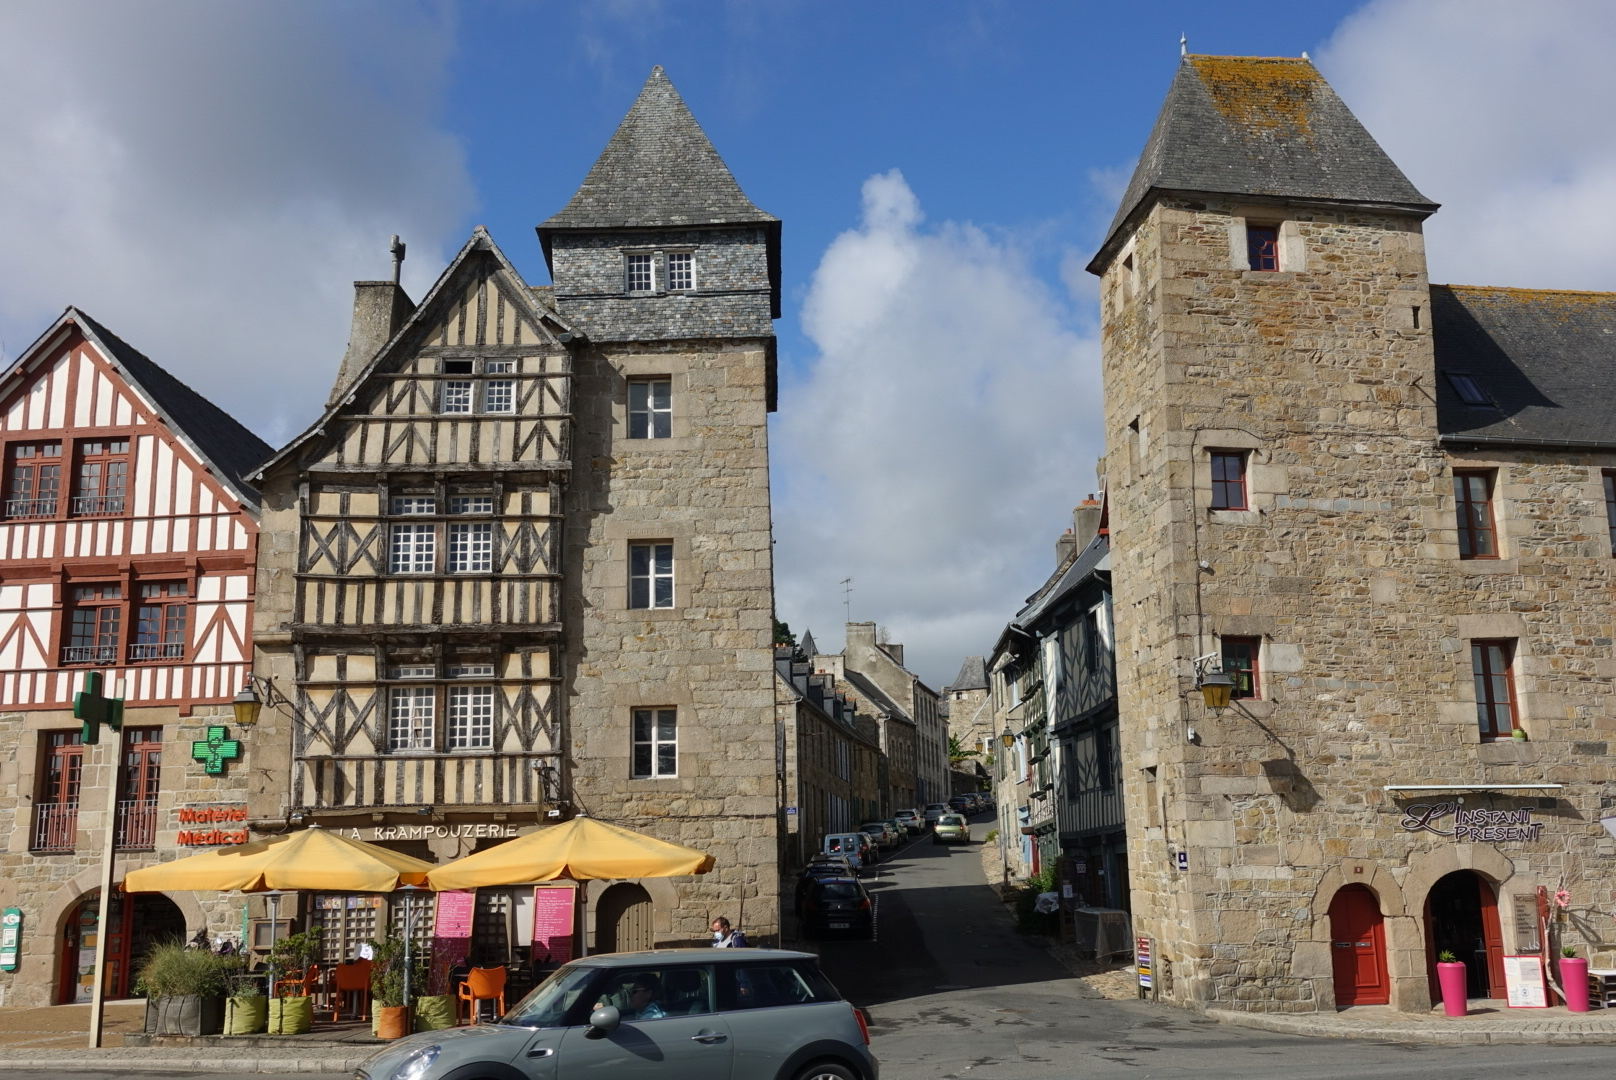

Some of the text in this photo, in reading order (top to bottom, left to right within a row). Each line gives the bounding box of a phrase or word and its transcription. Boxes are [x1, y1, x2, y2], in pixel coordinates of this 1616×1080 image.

[178, 806, 248, 823] Matériel
[177, 827, 249, 845] Médical
[373, 823, 518, 840] KRAMPOUZERIE
[1452, 822, 1545, 842] PRESENT
